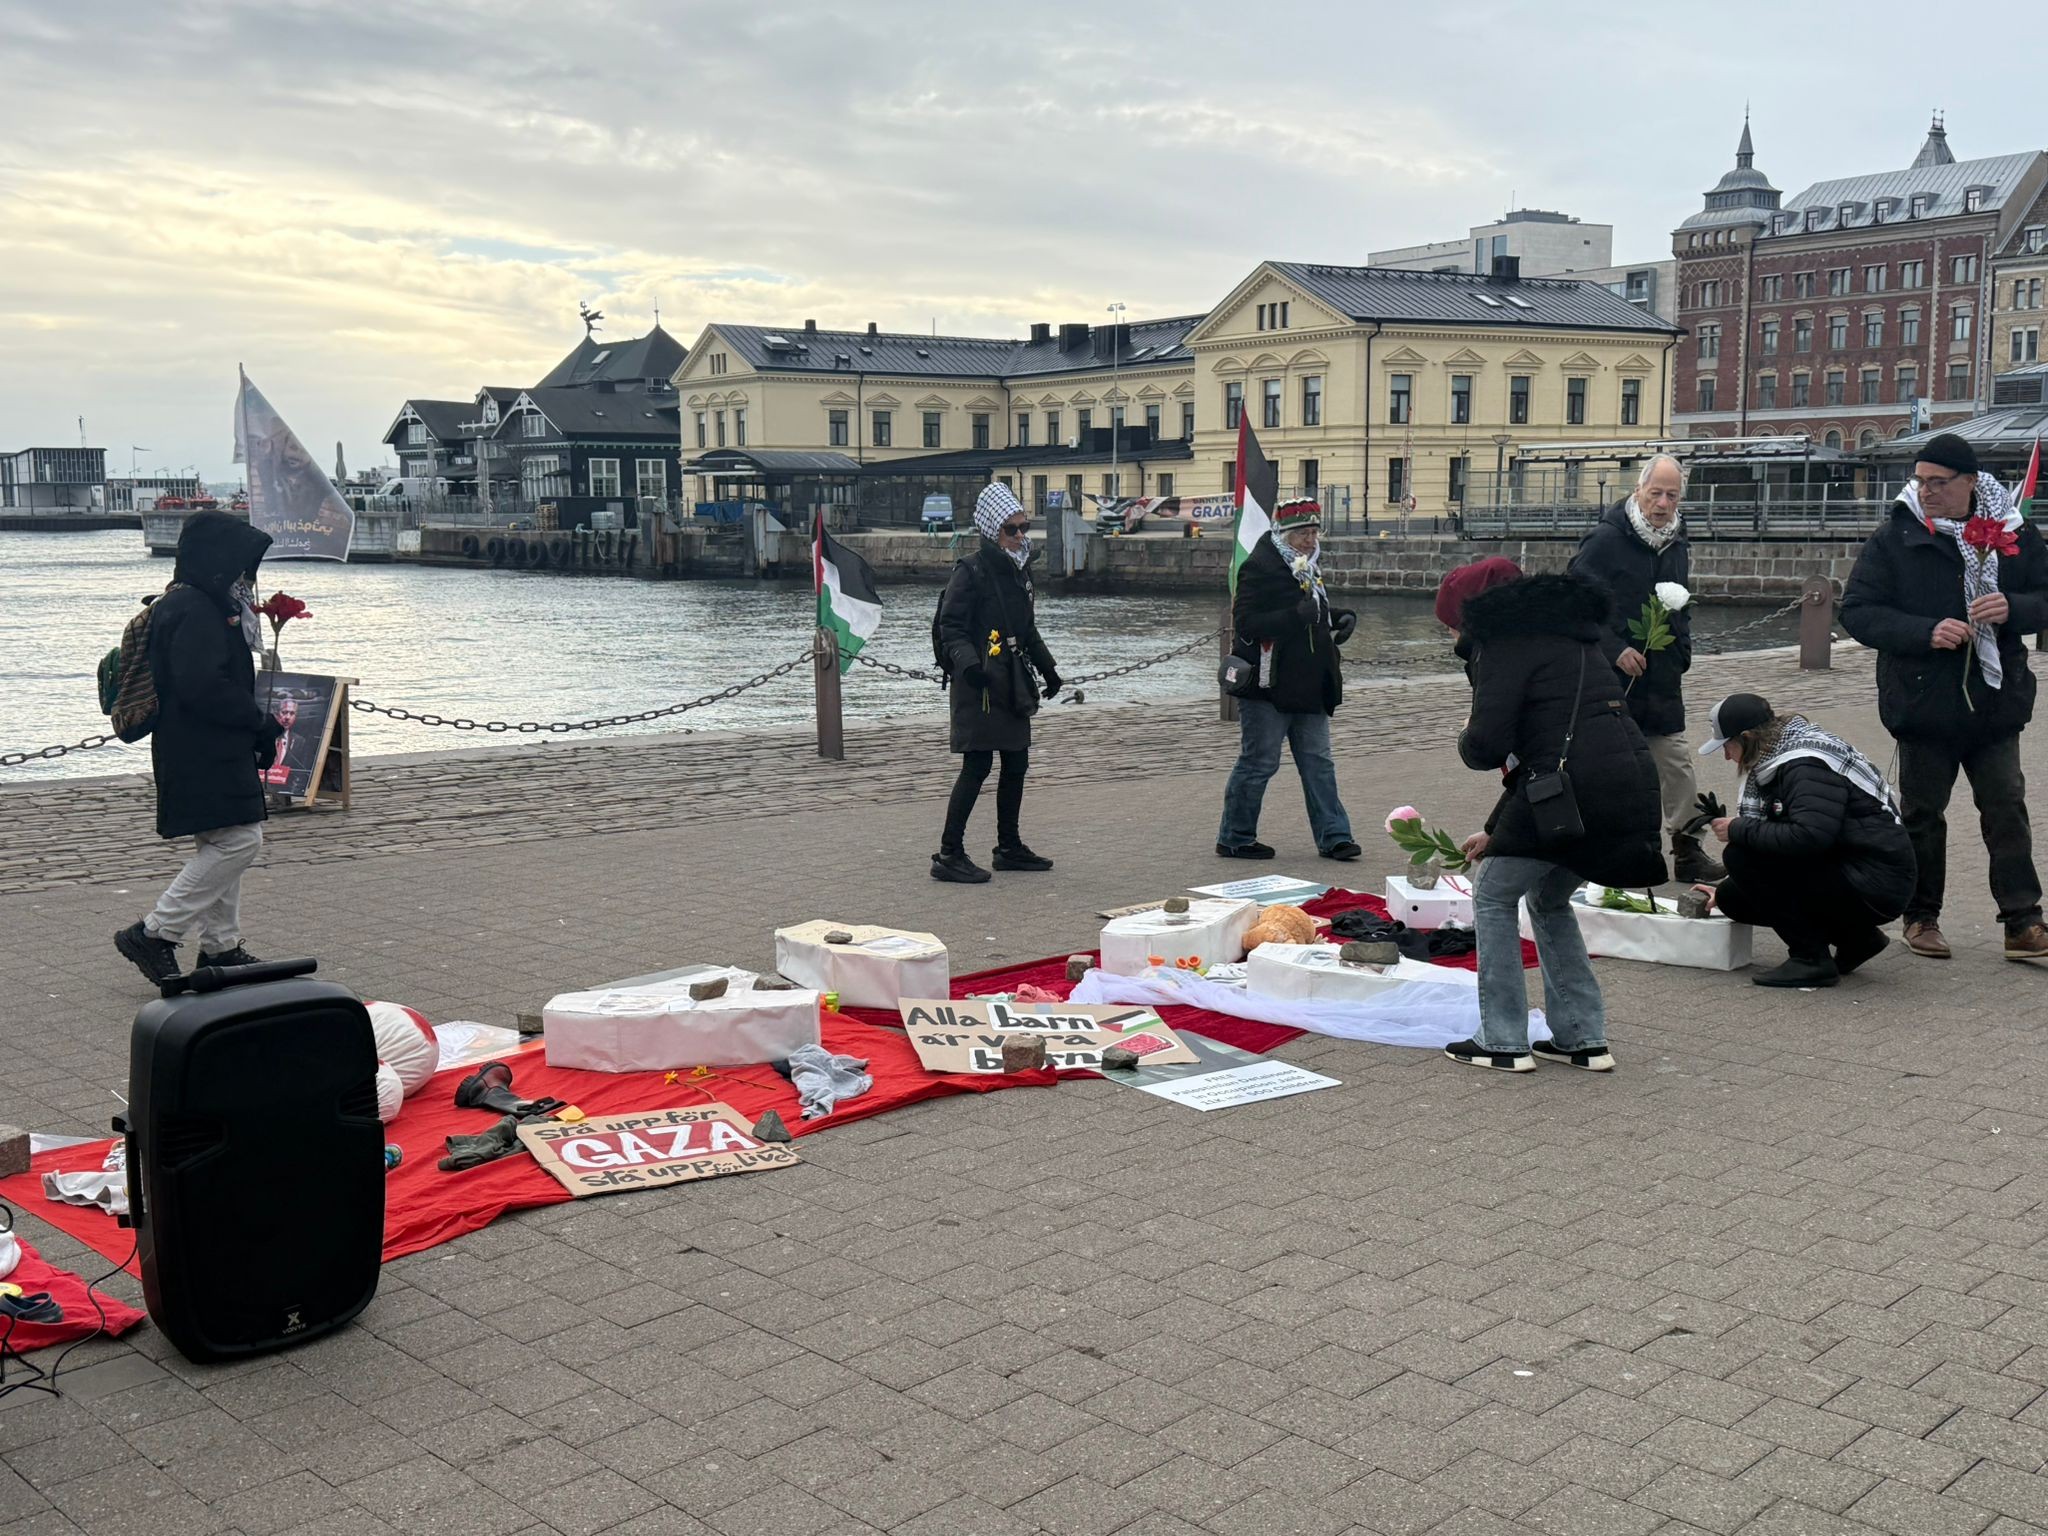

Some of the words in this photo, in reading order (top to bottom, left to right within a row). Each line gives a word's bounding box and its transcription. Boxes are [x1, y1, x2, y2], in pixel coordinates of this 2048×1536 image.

[1191, 505, 1234, 518] GRATI
[907, 1006, 987, 1027] Alla
[994, 1005, 1094, 1030] barn
[918, 1032, 969, 1047] är
[977, 1032, 1097, 1048] vra
[974, 1050, 1101, 1069] brn
[1172, 1081, 1239, 1095] Palestinian
[1238, 1069, 1298, 1083] Detainees
[1204, 1073, 1236, 1082] FREE
[1273, 1079, 1325, 1091] Children
[1207, 1081, 1277, 1097] Occupation
[606, 1115, 662, 1133] upp
[663, 1108, 719, 1125] för
[560, 1120, 762, 1168] GAZA
[709, 1162, 742, 1173] för
